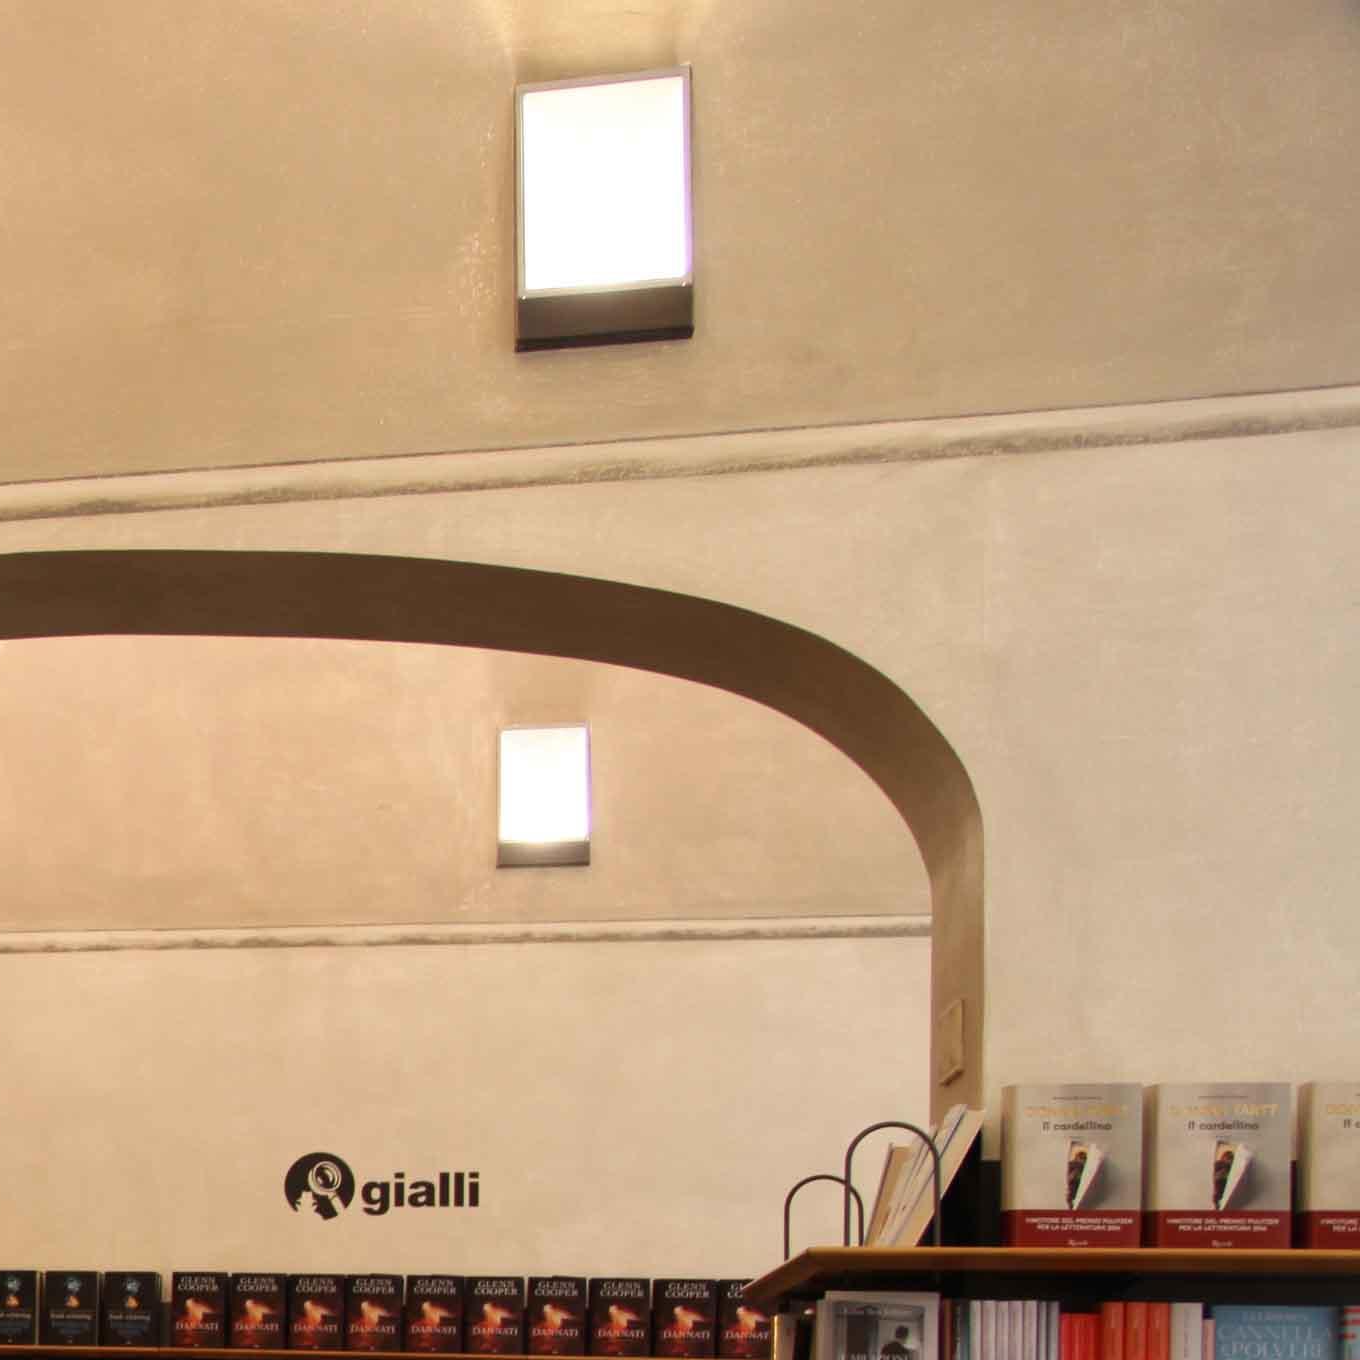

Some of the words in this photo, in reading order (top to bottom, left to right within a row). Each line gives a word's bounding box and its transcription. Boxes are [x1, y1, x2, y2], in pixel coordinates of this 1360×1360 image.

[1053, 1121, 1113, 1131] cardellino
[1198, 1121, 1259, 1131] cardellino
[360, 1170, 480, 1217] gialli
[179, 1276, 216, 1284] GLENN
[239, 1277, 275, 1285] GLENN
[298, 1278, 334, 1286] GLENN
[355, 1279, 392, 1287] GLENN
[416, 1279, 454, 1287] GLENN
[476, 1280, 515, 1288] GLENN
[178, 1283, 219, 1292] COOPER
[236, 1284, 278, 1293] COOPER
[295, 1285, 337, 1294] COOPER
[352, 1285, 395, 1294] COOPER
[537, 1281, 576, 1289] GLENN
[602, 1282, 641, 1290] GLENN
[667, 1282, 707, 1291] GLENN
[413, 1286, 456, 1295] COOPER
[474, 1287, 518, 1296] COOPER
[534, 1287, 578, 1297] COOPER
[599, 1288, 644, 1298] COOPER
[664, 1289, 709, 1299] COOPER
[725, 1331, 769, 1340] DANNAT
